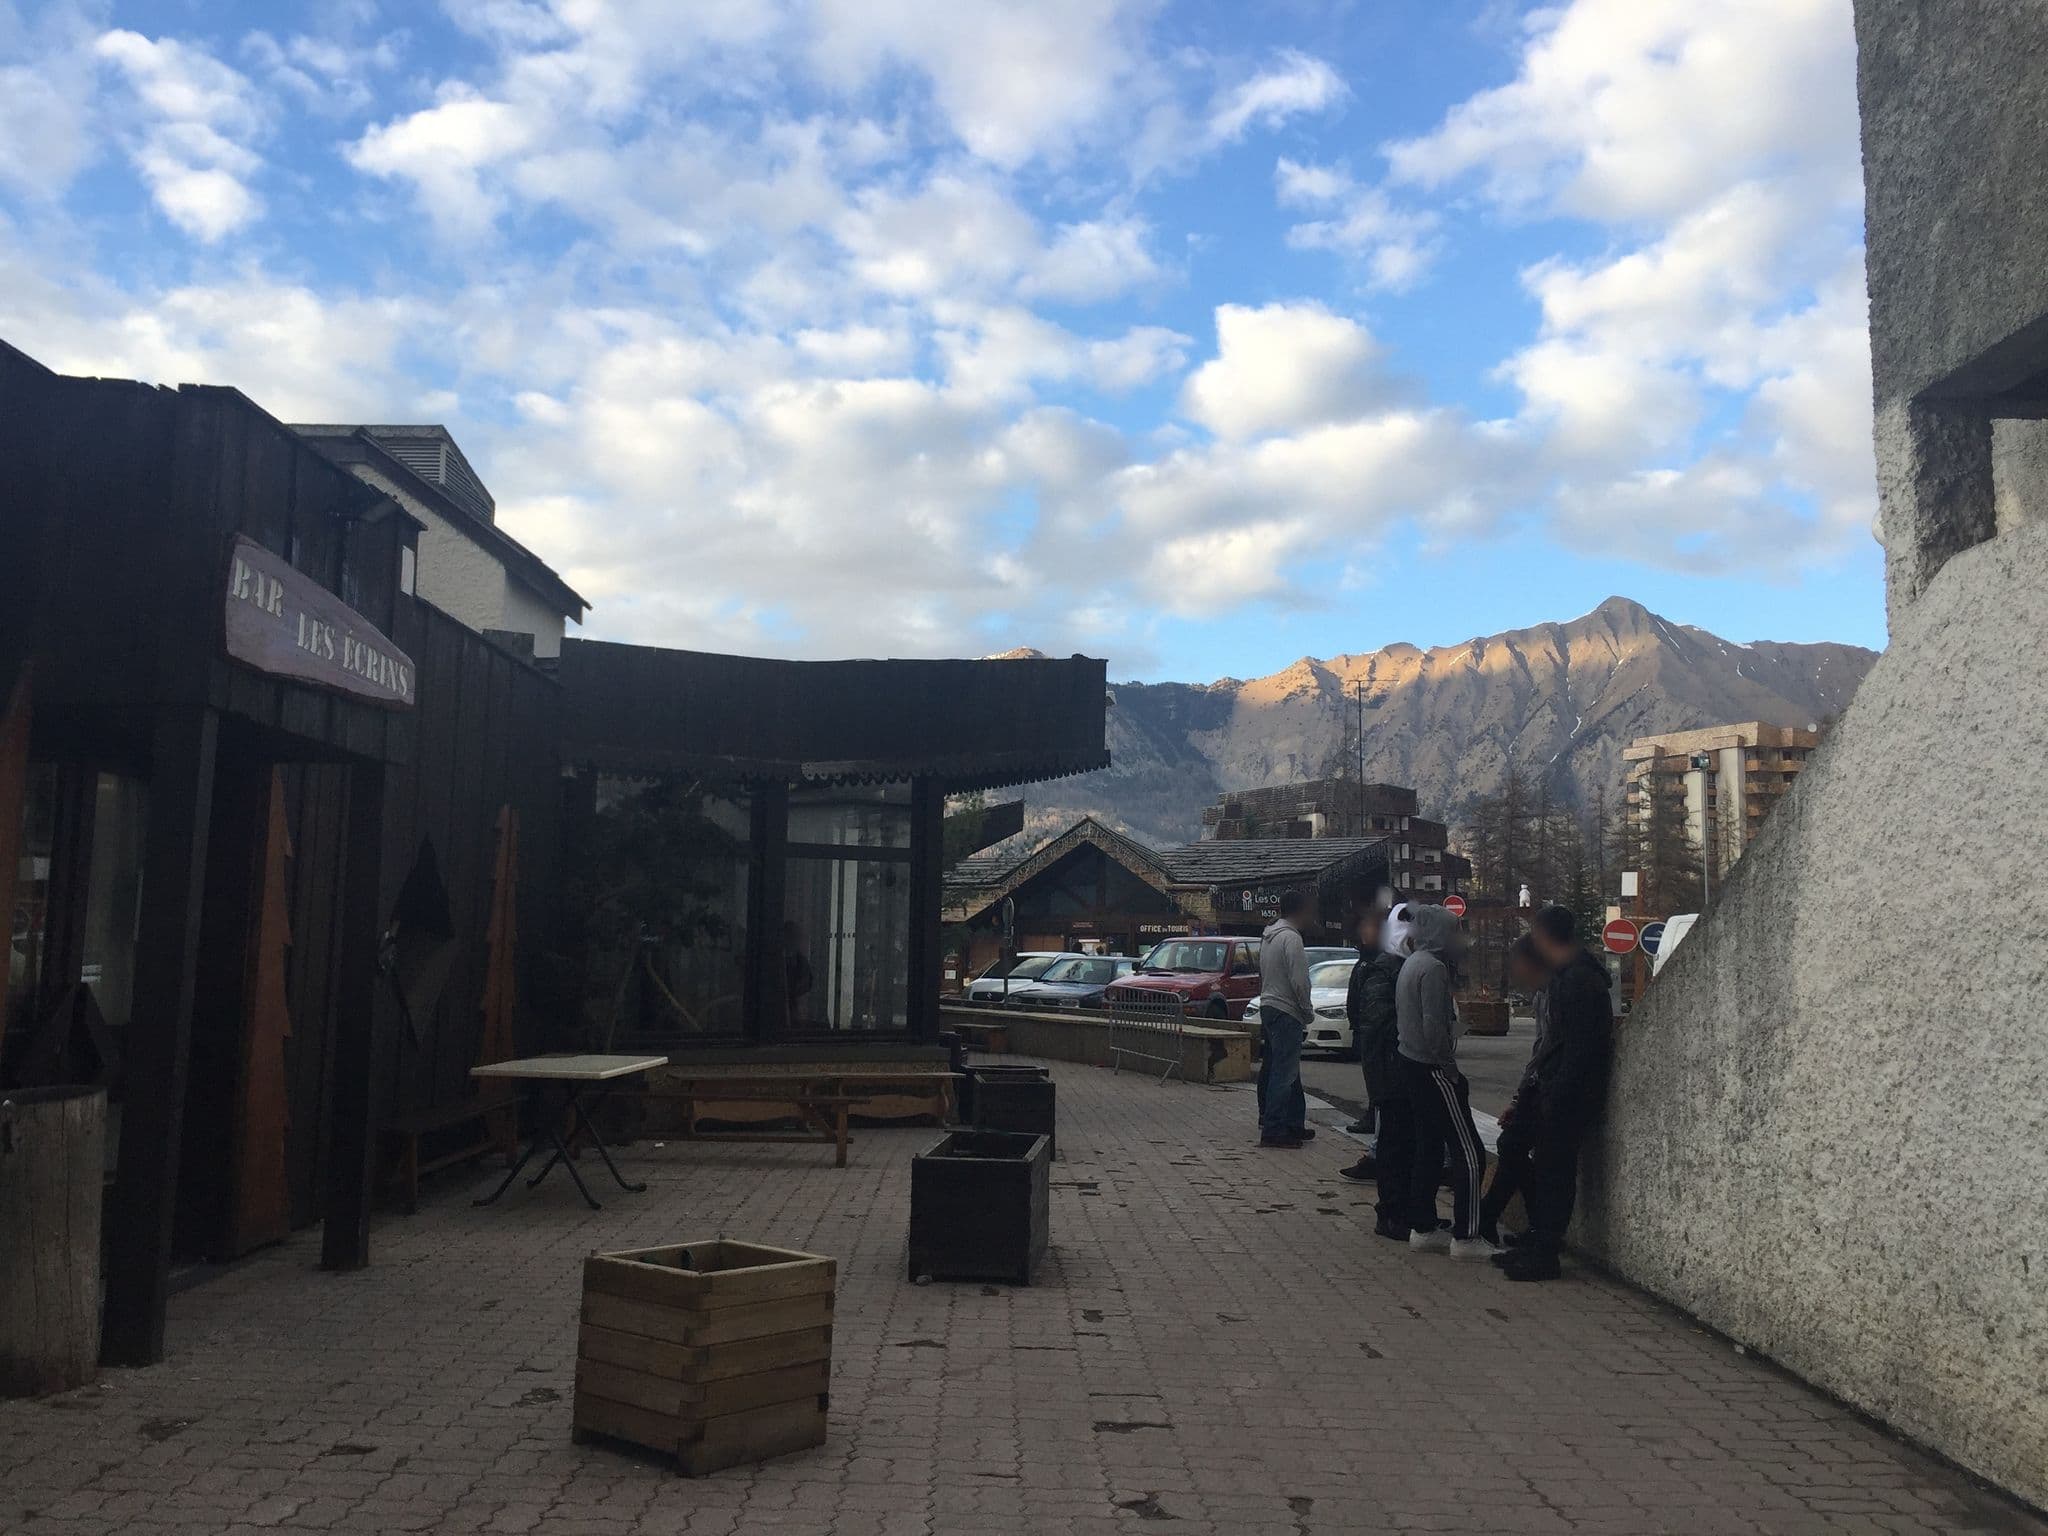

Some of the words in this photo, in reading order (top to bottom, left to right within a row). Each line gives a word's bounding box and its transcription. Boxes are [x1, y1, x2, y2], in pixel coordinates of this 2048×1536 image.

[232, 558, 284, 618] BAR
[297, 612, 336, 660] LES
[342, 629, 408, 696] ÉCRINS
[1254, 894, 1269, 903] Les
[1139, 924, 1161, 933] OFFICE
[1167, 924, 1189, 933] TOURIS
